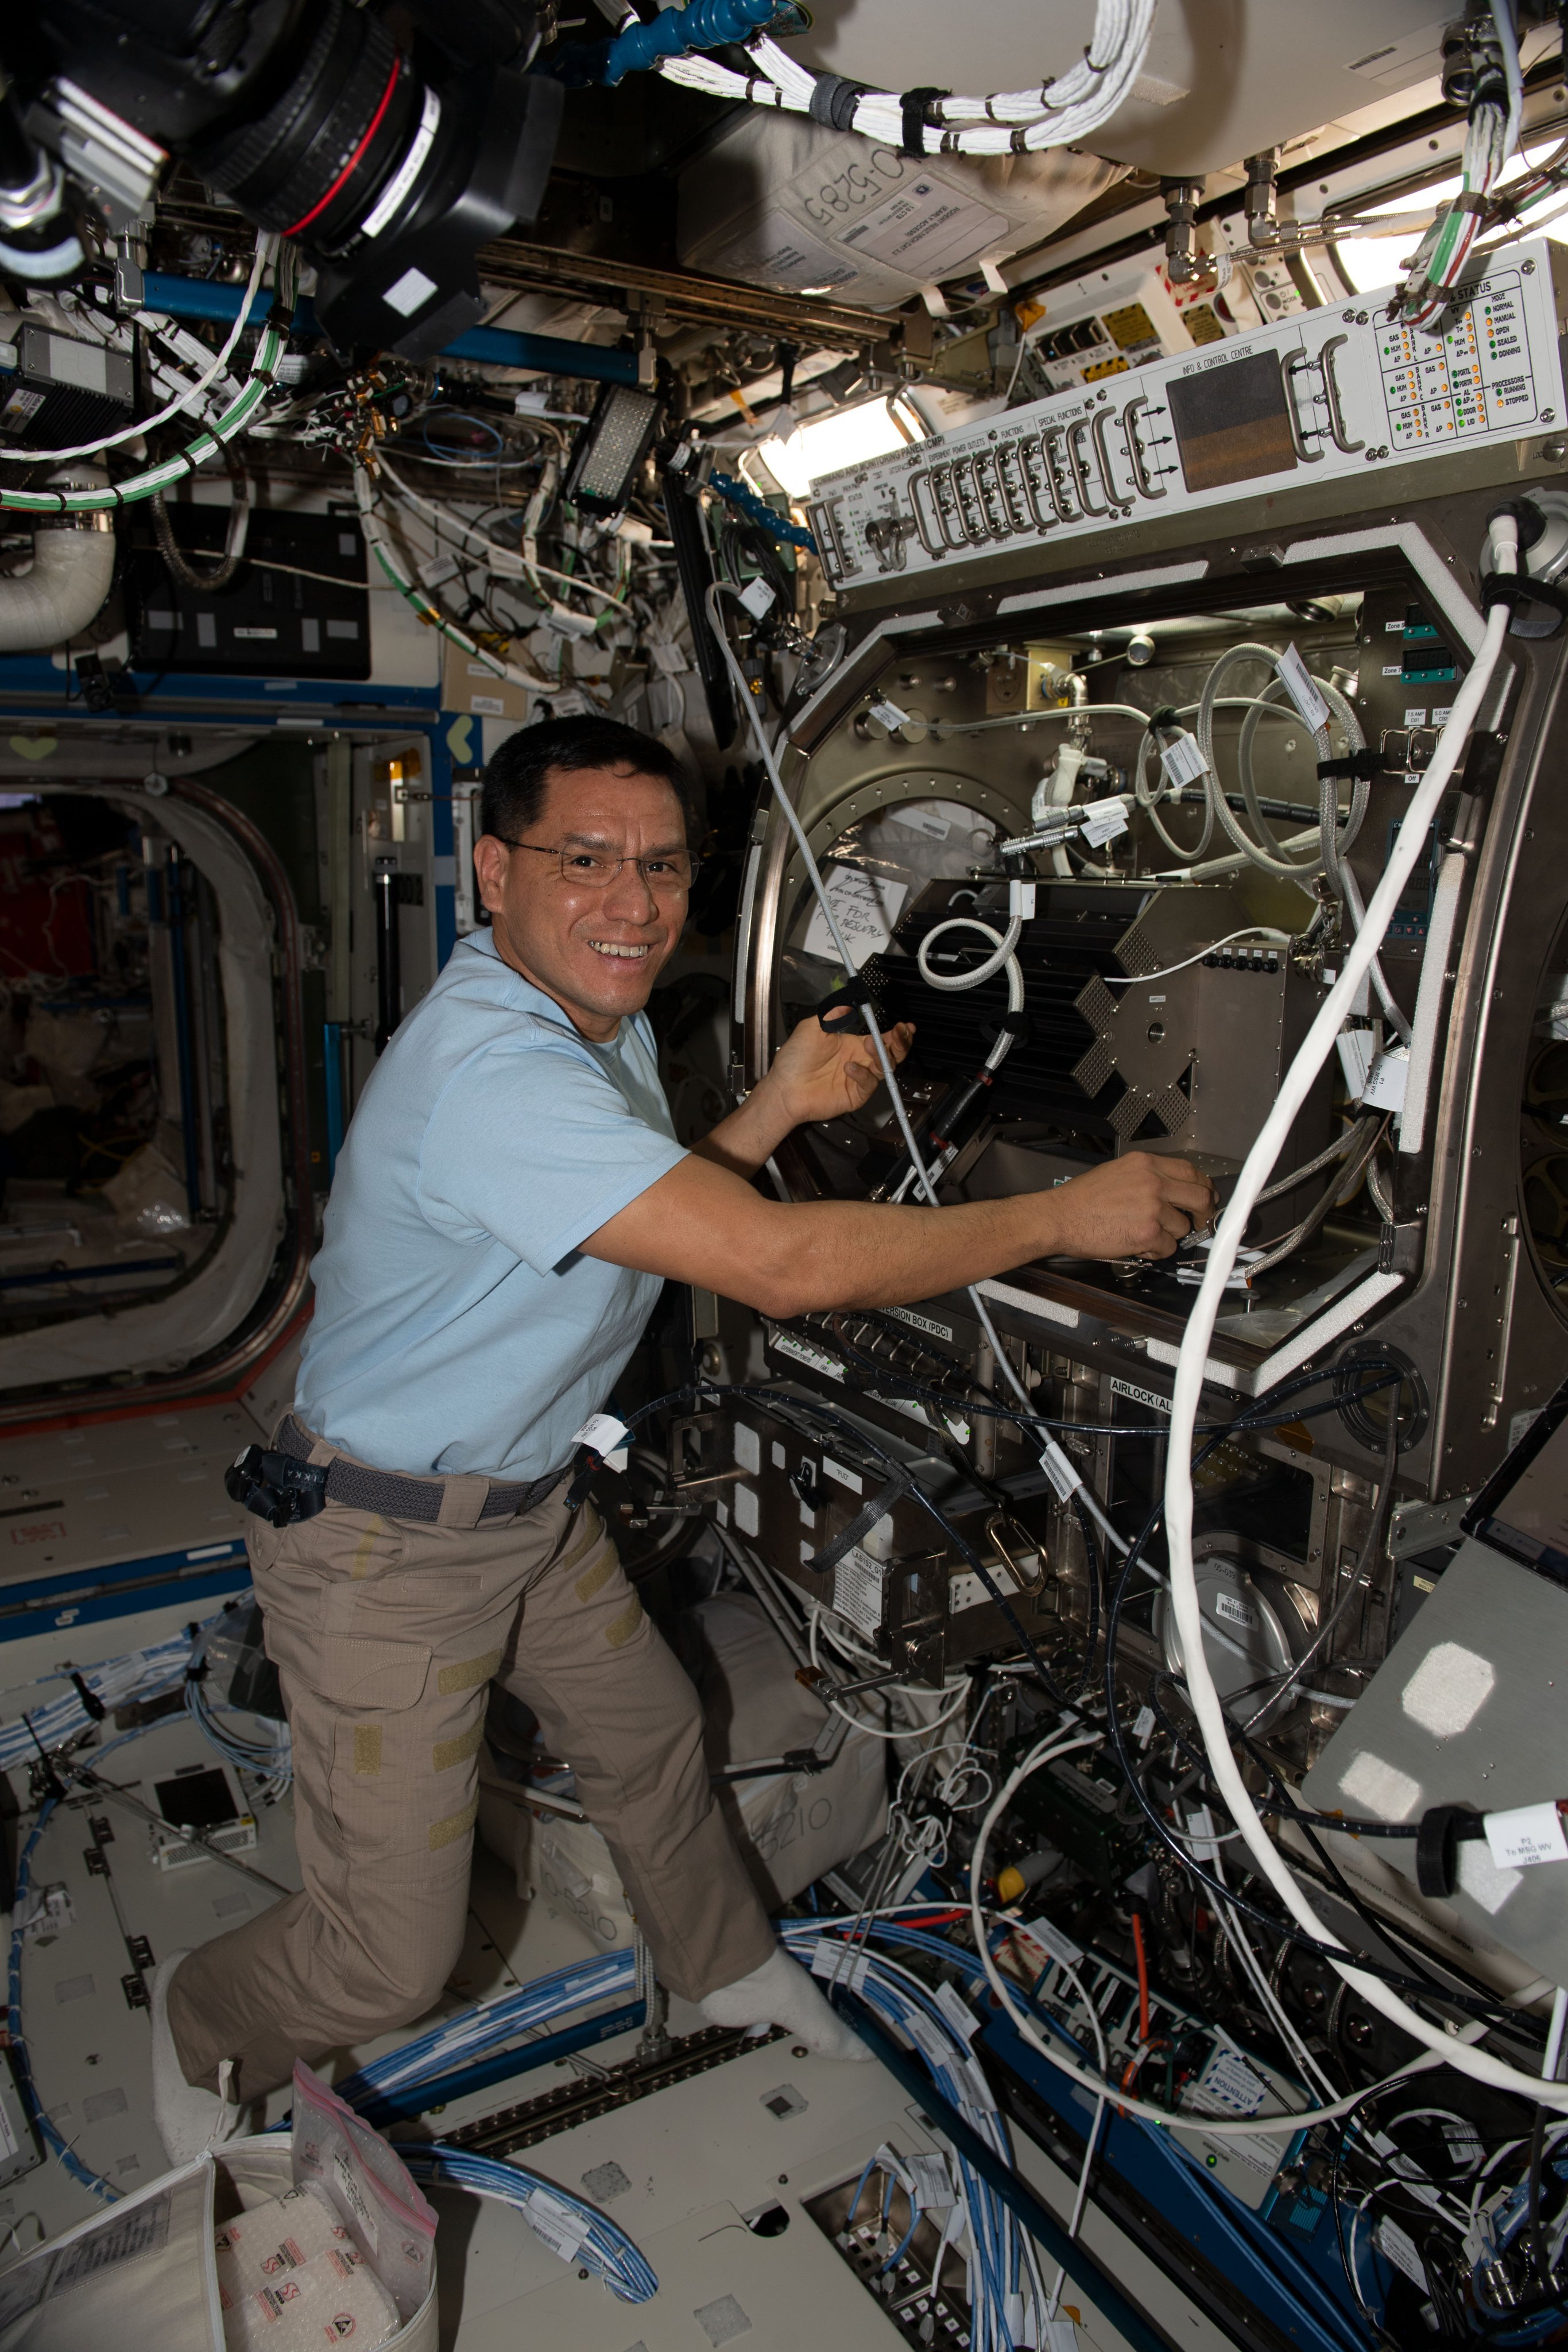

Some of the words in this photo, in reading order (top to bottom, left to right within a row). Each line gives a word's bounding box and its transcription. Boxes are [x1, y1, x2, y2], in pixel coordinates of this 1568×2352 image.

[896, 211, 907, 219] CTB
[938, 207, 960, 224] RODENT
[1458, 281, 1491, 300] STATUS
[1492, 293, 1505, 302] MODE
[1493, 301, 1514, 313] NORMAL
[1494, 313, 1516, 323] MANUAL
[1496, 326, 1509, 335] OPEN
[1454, 338, 1465, 346] HUM
[1497, 336, 1517, 346] SEALED
[1391, 345, 1401, 353] HUM
[1499, 346, 1521, 358] DONNING
[1183, 364, 1195, 375] INFO
[1197, 362, 1201, 370] &
[1204, 354, 1228, 368] CONTROL
[1231, 345, 1253, 359] CENTRE
[1425, 366, 1435, 374] GAS
[1397, 384, 1407, 392] HUM
[1492, 376, 1524, 389] PROCESSORS
[1504, 383, 1526, 395] RUNNING
[1505, 394, 1529, 405] STOPPED
[1431, 404, 1441, 412] GAS
[1464, 407, 1476, 415] DOOR
[1039, 415, 1056, 427] SPECIAL
[1058, 407, 1082, 420] FUNCTIONS
[1401, 411, 1411, 419] GAS
[1001, 425, 1024, 438] FUNCTIONS
[1402, 422, 1412, 430] HUM
[929, 449, 951, 461] EXPERIMENT
[953, 444, 966, 457] POWER
[968, 440, 985, 451] OUTLETS
[813, 467, 845, 486] COMMAND
[845, 465, 858, 476] AND
[860, 451, 900, 472] MONITORING
[902, 443, 924, 458] PANEL
[924, 436, 945, 451] (CMP)
[846, 905, 870, 922] FOR
[841, 919, 884, 938] RESUPPLY
[1370, 1086, 1376, 1096] WV
[881, 1307, 911, 1322] VERSION
[912, 1315, 927, 1329] BOX
[928, 1321, 948, 1338] (PDC)
[780, 1344, 799, 1359] EXPERIMENT
[799, 1352, 812, 1363] POWERS
[1112, 1380, 1154, 1405] AIRLOCK
[1156, 1396, 1172, 1412] (AL
[852, 1550, 881, 1576] LAB1S2_G1
[1421, 1579, 1435, 1589] PROTEC
[1521, 1838, 1531, 1846] P2
[1518, 1846, 1537, 1855] MSG
[1539, 1843, 1552, 1851] WV
[1344, 1864, 1362, 1881] REMOTE
[1364, 1878, 1382, 1893] POWER
[1383, 1890, 1419, 1917] DISTRIBUTION
[1420, 1914, 1447, 1935] ASSEMBLY
[1451, 1935, 1474, 1953] (RPDA)
[1214, 2077, 1253, 2106] ATTENTION
[1197, 2092, 1215, 2107] Inverter
[1203, 2141, 1217, 2153] POWER
[1260, 2136, 1281, 2154] Thermal
[1217, 2151, 1229, 2163] INPUT
